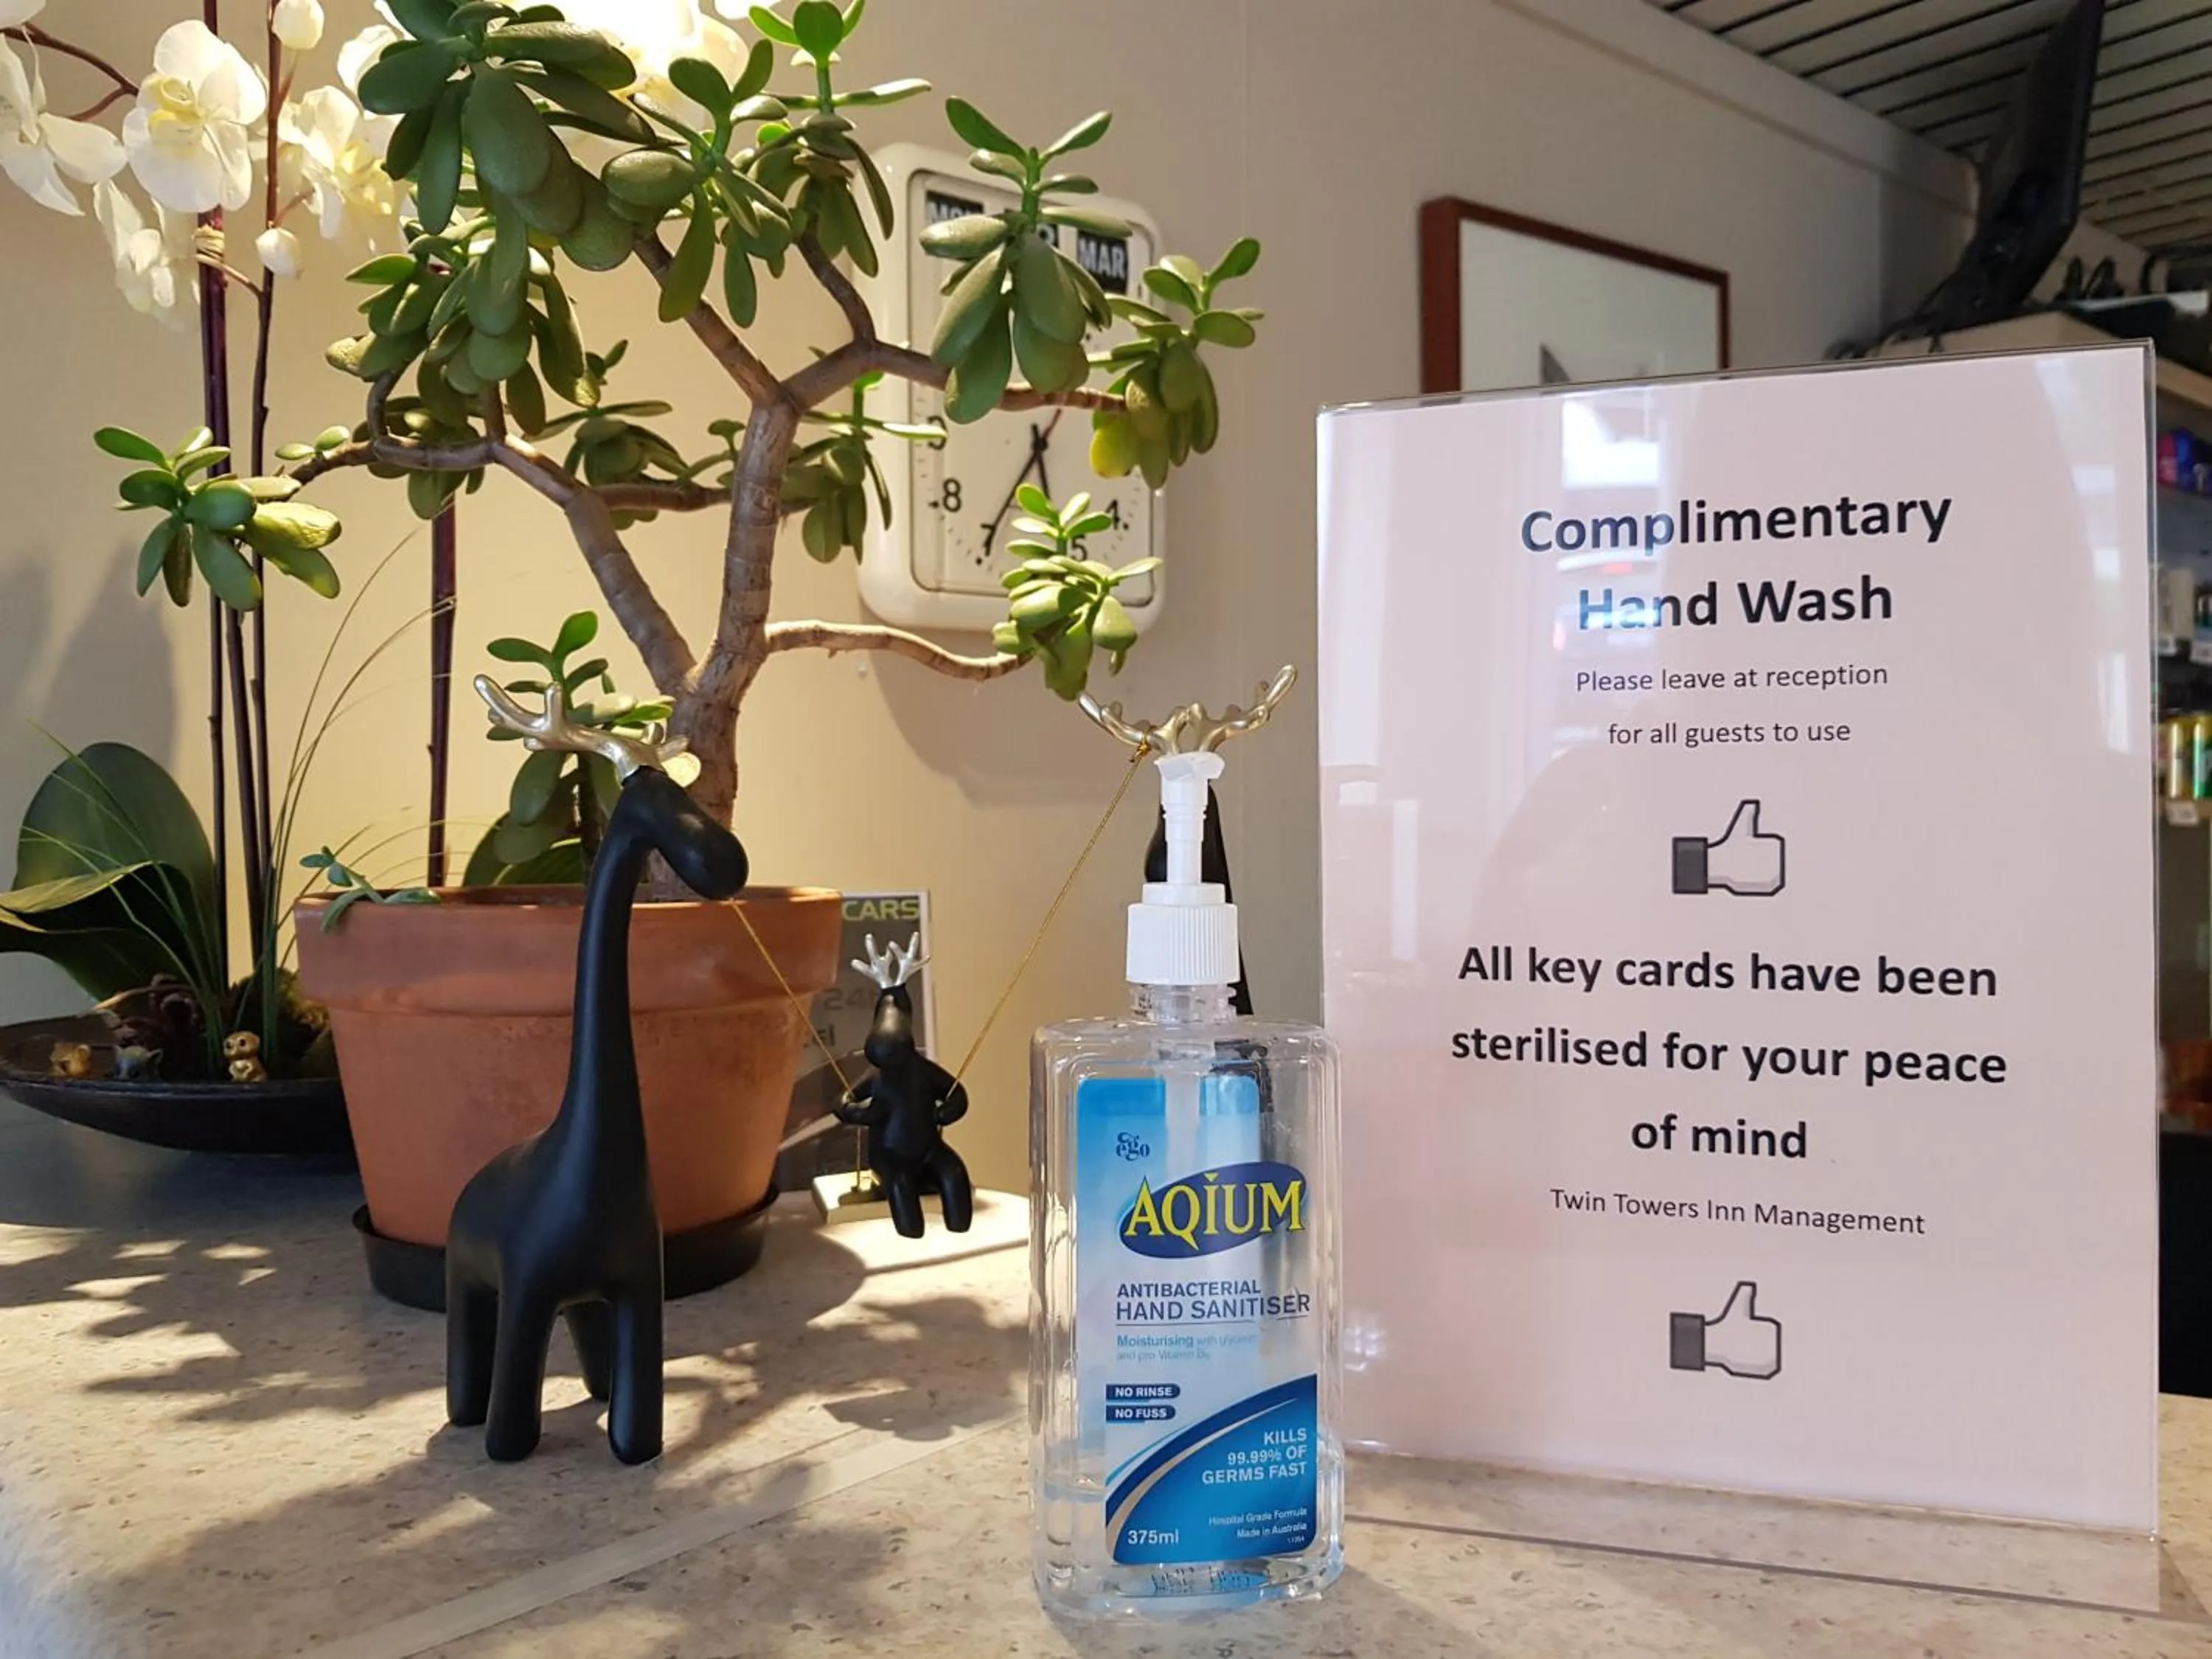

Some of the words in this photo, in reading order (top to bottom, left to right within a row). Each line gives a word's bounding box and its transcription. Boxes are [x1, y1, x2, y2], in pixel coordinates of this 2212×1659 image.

[1079, 237, 1125, 278] MAR
[943, 479, 961, 512] 8
[1521, 496, 1952, 555] Complimentary
[981, 523, 995, 556] 7
[1579, 581, 1717, 630] Hand
[1737, 574, 1892, 624] Wash
[1576, 669, 1653, 692] Please
[1661, 668, 1725, 690] leave
[1733, 669, 1758, 688] at
[1765, 664, 1888, 690] reception
[1608, 723, 1642, 744] for
[1649, 723, 1677, 744] all
[1685, 723, 1764, 748] guests
[1773, 722, 1798, 742] to
[1807, 723, 1851, 741] use
[842, 900, 920, 921] CARS
[1458, 946, 1513, 981] All
[1528, 947, 1602, 992] key
[1615, 952, 1735, 989] cards
[1750, 953, 1860, 993] have
[1878, 956, 1997, 996] been
[1451, 1027, 1648, 1068] sterilised
[1663, 1032, 1728, 1071] for
[1742, 1043, 1849, 1082] your
[1865, 1051, 2007, 1087] peace
[1116, 1132, 1150, 1161] ego
[1630, 1113, 1677, 1150] of
[1691, 1119, 1807, 1158] mind
[1550, 1189, 1606, 1213] Twin
[1613, 1193, 1699, 1219] Towers
[1707, 1199, 1745, 1222] Inn
[1754, 1203, 1926, 1234] Management
[1117, 1279, 1262, 1298] ANTIBACTERIAL
[1116, 1301, 1183, 1321] HAND
[1191, 1294, 1311, 1319] SANITISER
[1117, 1334, 1194, 1347] Moisturising
[1117, 1350, 1136, 1360] and
[1115, 1386, 1134, 1397] NO
[1136, 1386, 1173, 1397] RINSE
[1115, 1408, 1134, 1418] NO
[1136, 1408, 1167, 1418] FUSS
[1263, 1428, 1307, 1445] KILLS
[1228, 1450, 1282, 1466] 99.99%
[1286, 1445, 1308, 1461] OF
[1202, 1468, 1265, 1485] GERMS
[1269, 1462, 1307, 1479] FAST
[1127, 1529, 1180, 1545] 375ml
[1237, 1527, 1261, 1539] Made
[1262, 1526, 1271, 1535] in
[1272, 1522, 1308, 1535] Australia
